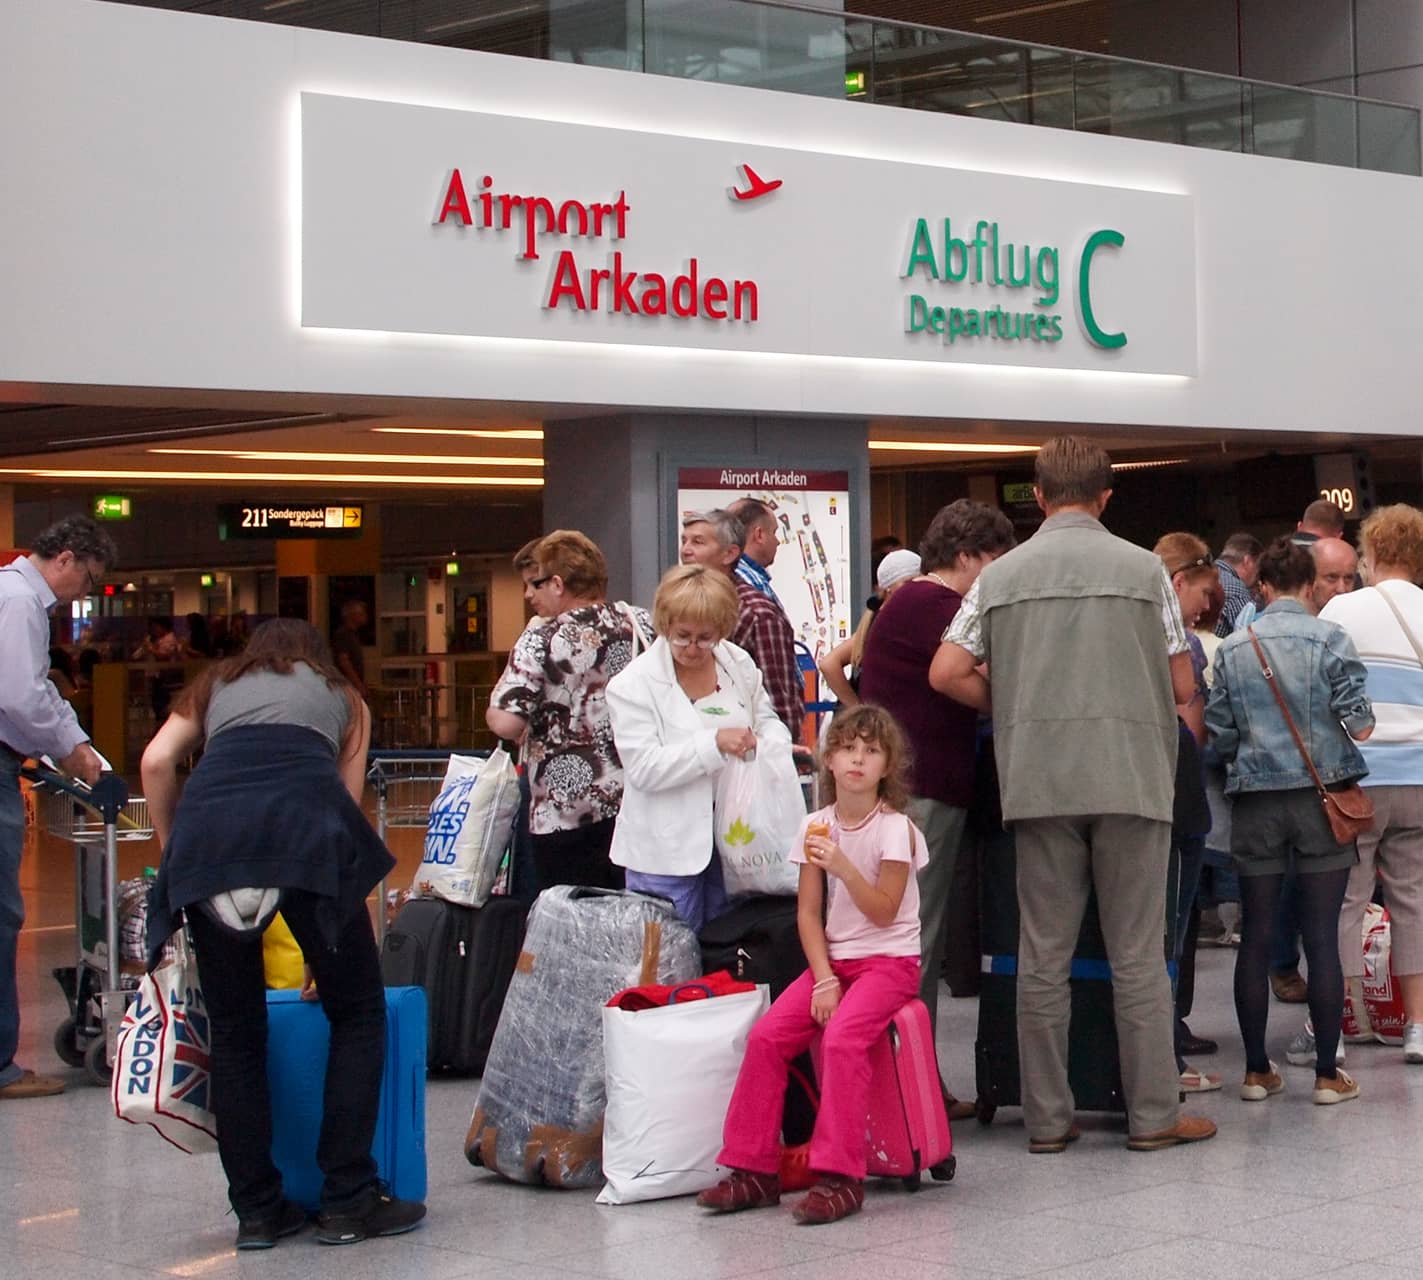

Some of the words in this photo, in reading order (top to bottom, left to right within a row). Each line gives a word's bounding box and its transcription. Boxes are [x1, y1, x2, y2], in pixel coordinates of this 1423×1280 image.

[436, 167, 631, 260] Airport
[544, 250, 758, 321] Arkaden
[902, 216, 1060, 306] Abflug
[1075, 229, 1128, 350] C
[906, 294, 1063, 345] Departures
[720, 469, 760, 489] Airport
[761, 471, 808, 487] Arkaden
[241, 508, 269, 528] 211
[268, 508, 324, 521] Sondergepäck
[740, 851, 783, 867] NOVA
